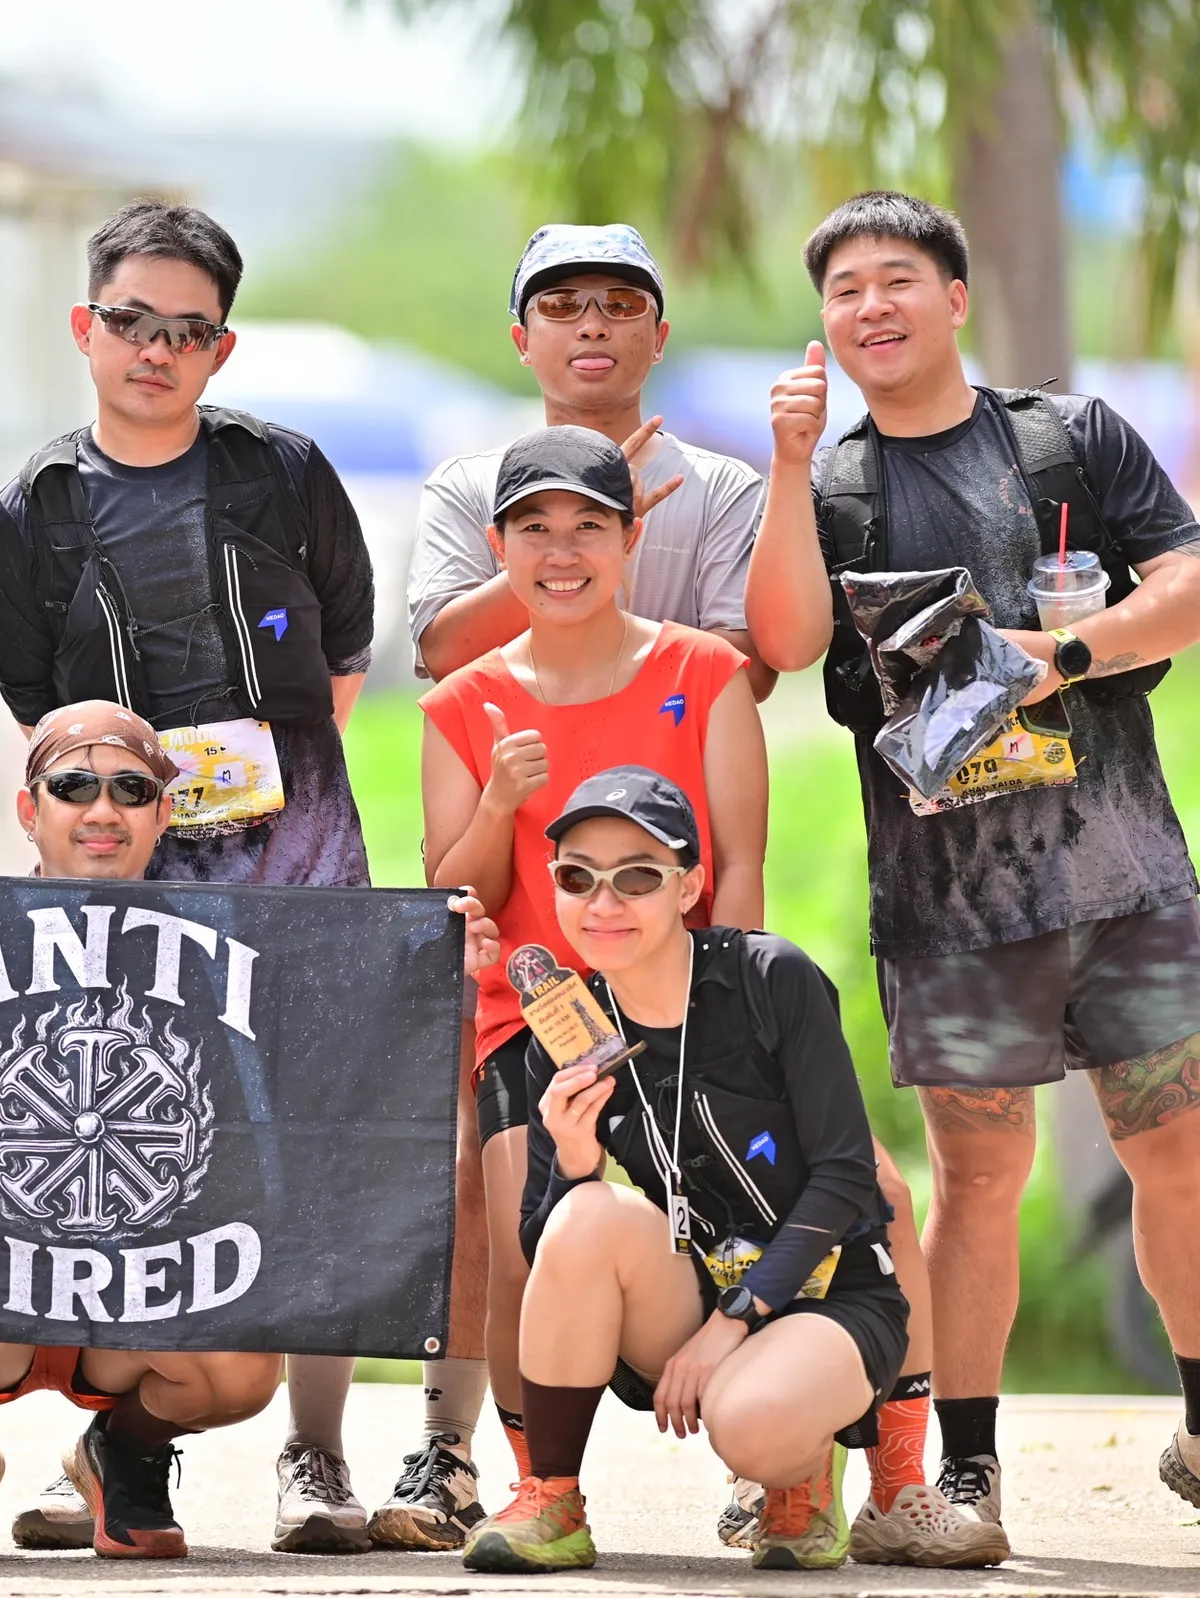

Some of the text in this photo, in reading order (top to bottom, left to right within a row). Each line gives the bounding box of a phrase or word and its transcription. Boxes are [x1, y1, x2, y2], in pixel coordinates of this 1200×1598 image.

[1010, 741, 1020, 753] M
[991, 781, 1008, 790] YAI
[1010, 778, 1023, 786] DA
[530, 976, 561, 999] TRAIL
[677, 1206, 687, 1235] 2
